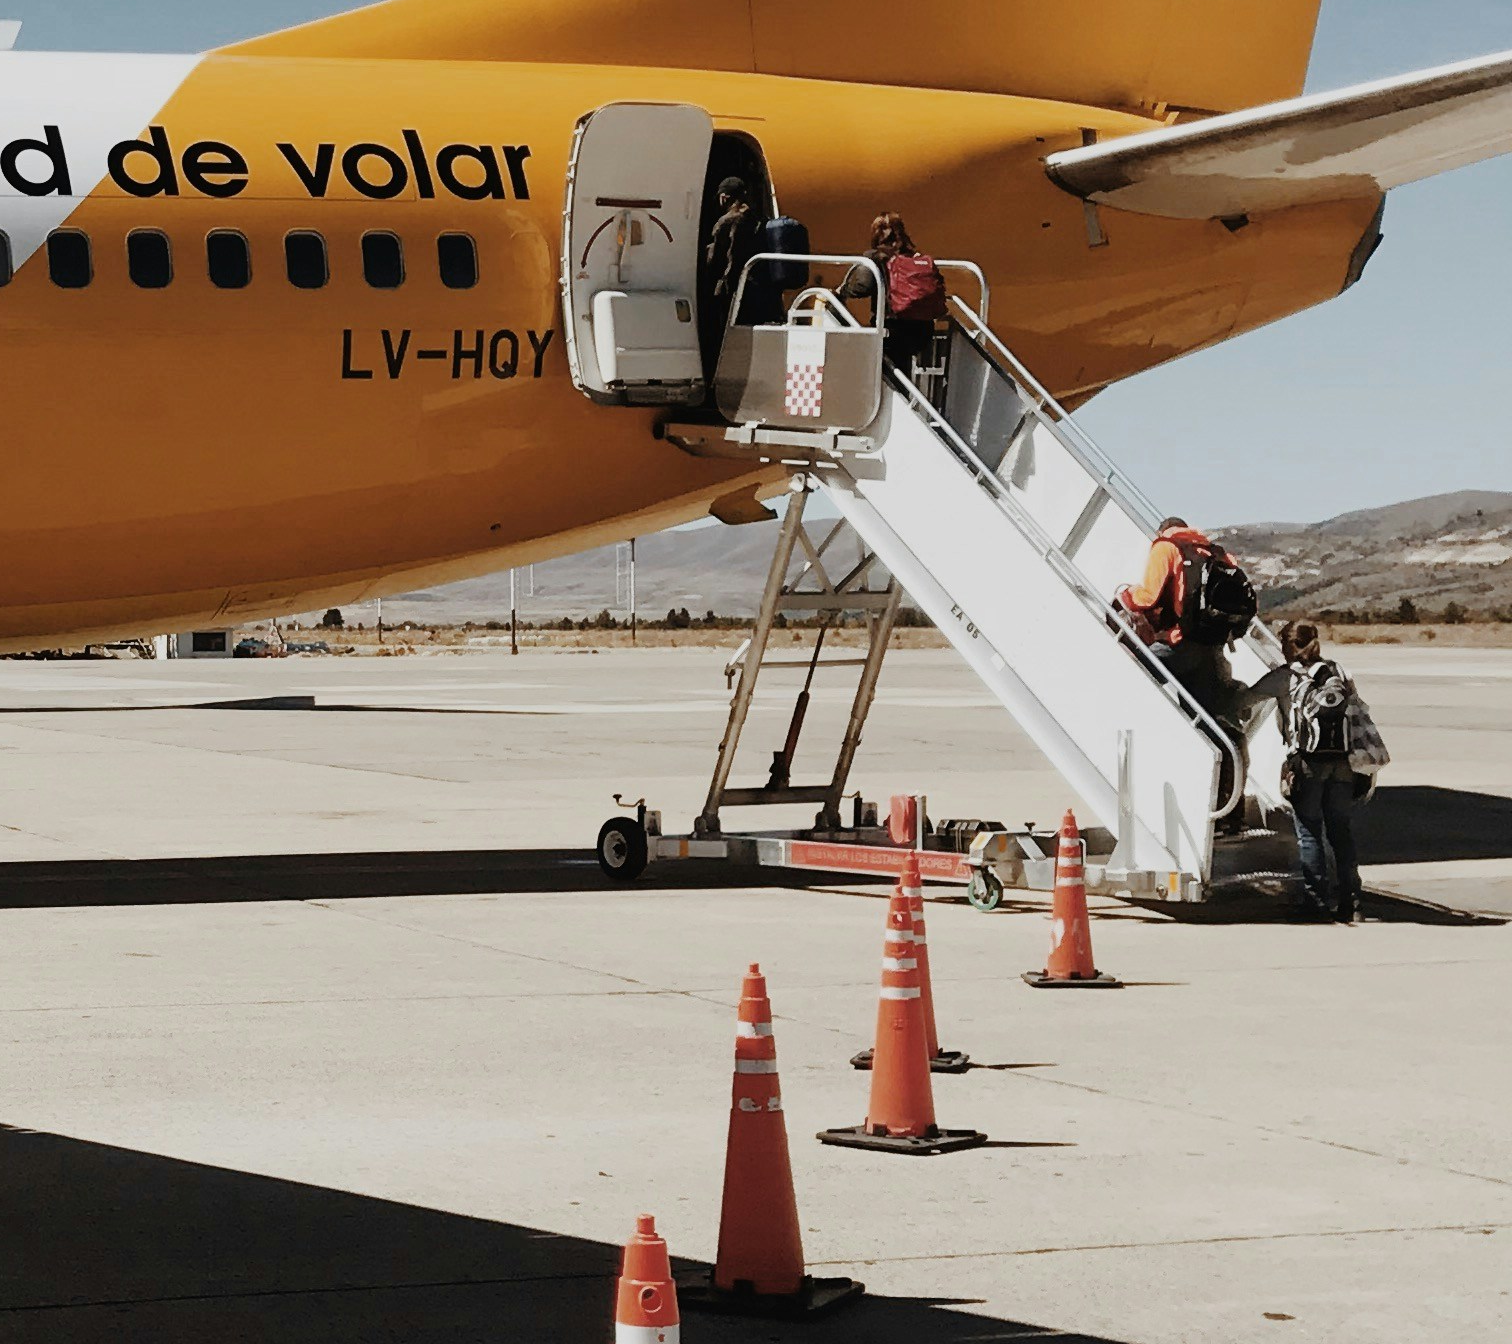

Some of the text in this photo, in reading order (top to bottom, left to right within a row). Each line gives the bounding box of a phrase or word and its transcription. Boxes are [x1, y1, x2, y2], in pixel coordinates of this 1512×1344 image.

[107, 126, 249, 199] de
[275, 129, 532, 201] volar
[341, 328, 555, 381] LV-HQY
